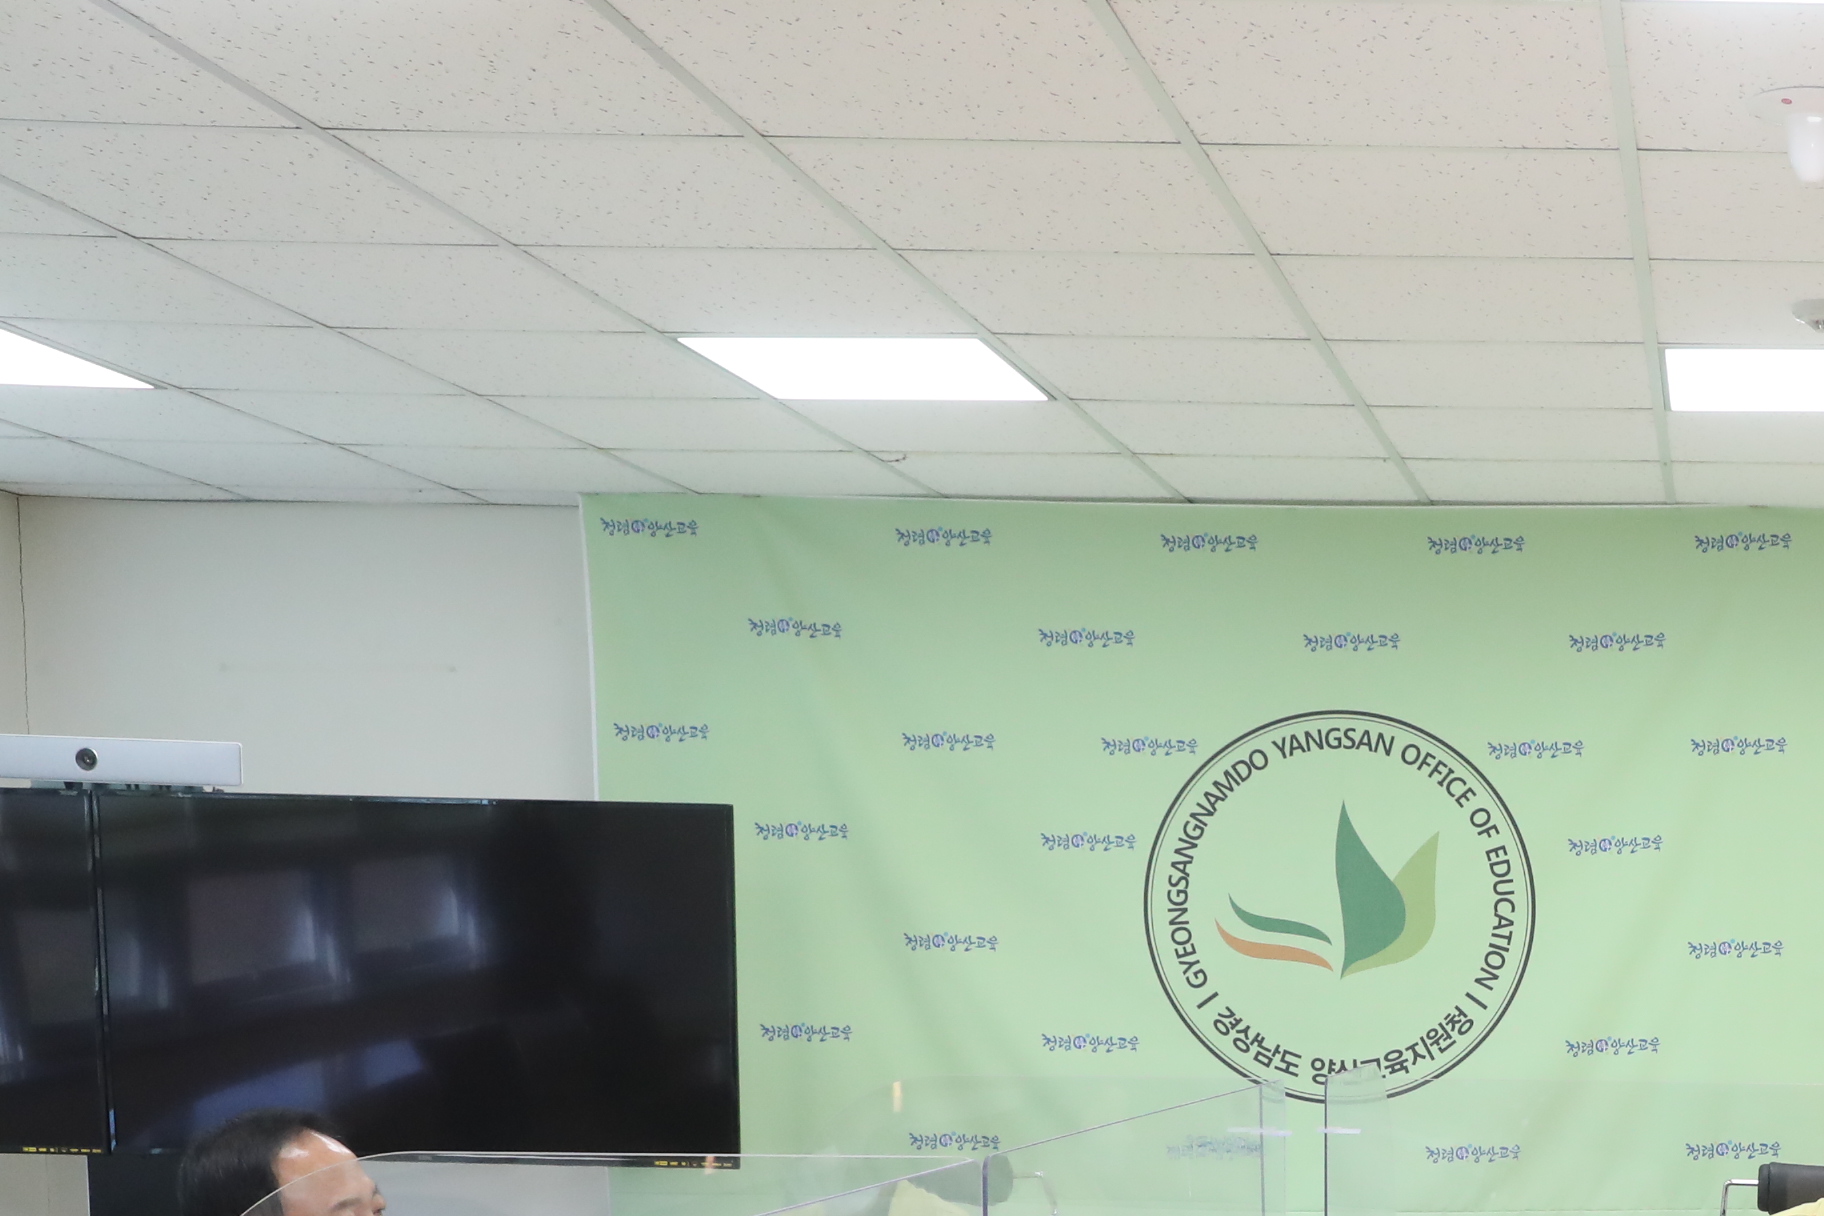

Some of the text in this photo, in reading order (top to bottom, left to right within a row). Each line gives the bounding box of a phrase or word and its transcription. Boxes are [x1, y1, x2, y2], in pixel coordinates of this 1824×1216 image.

[1167, 727, 1516, 990] GYEONGSANGNAMDO YANGSAN OFFICE OF EDUCATION
[1212, 1006, 1301, 1078] 경상남도
